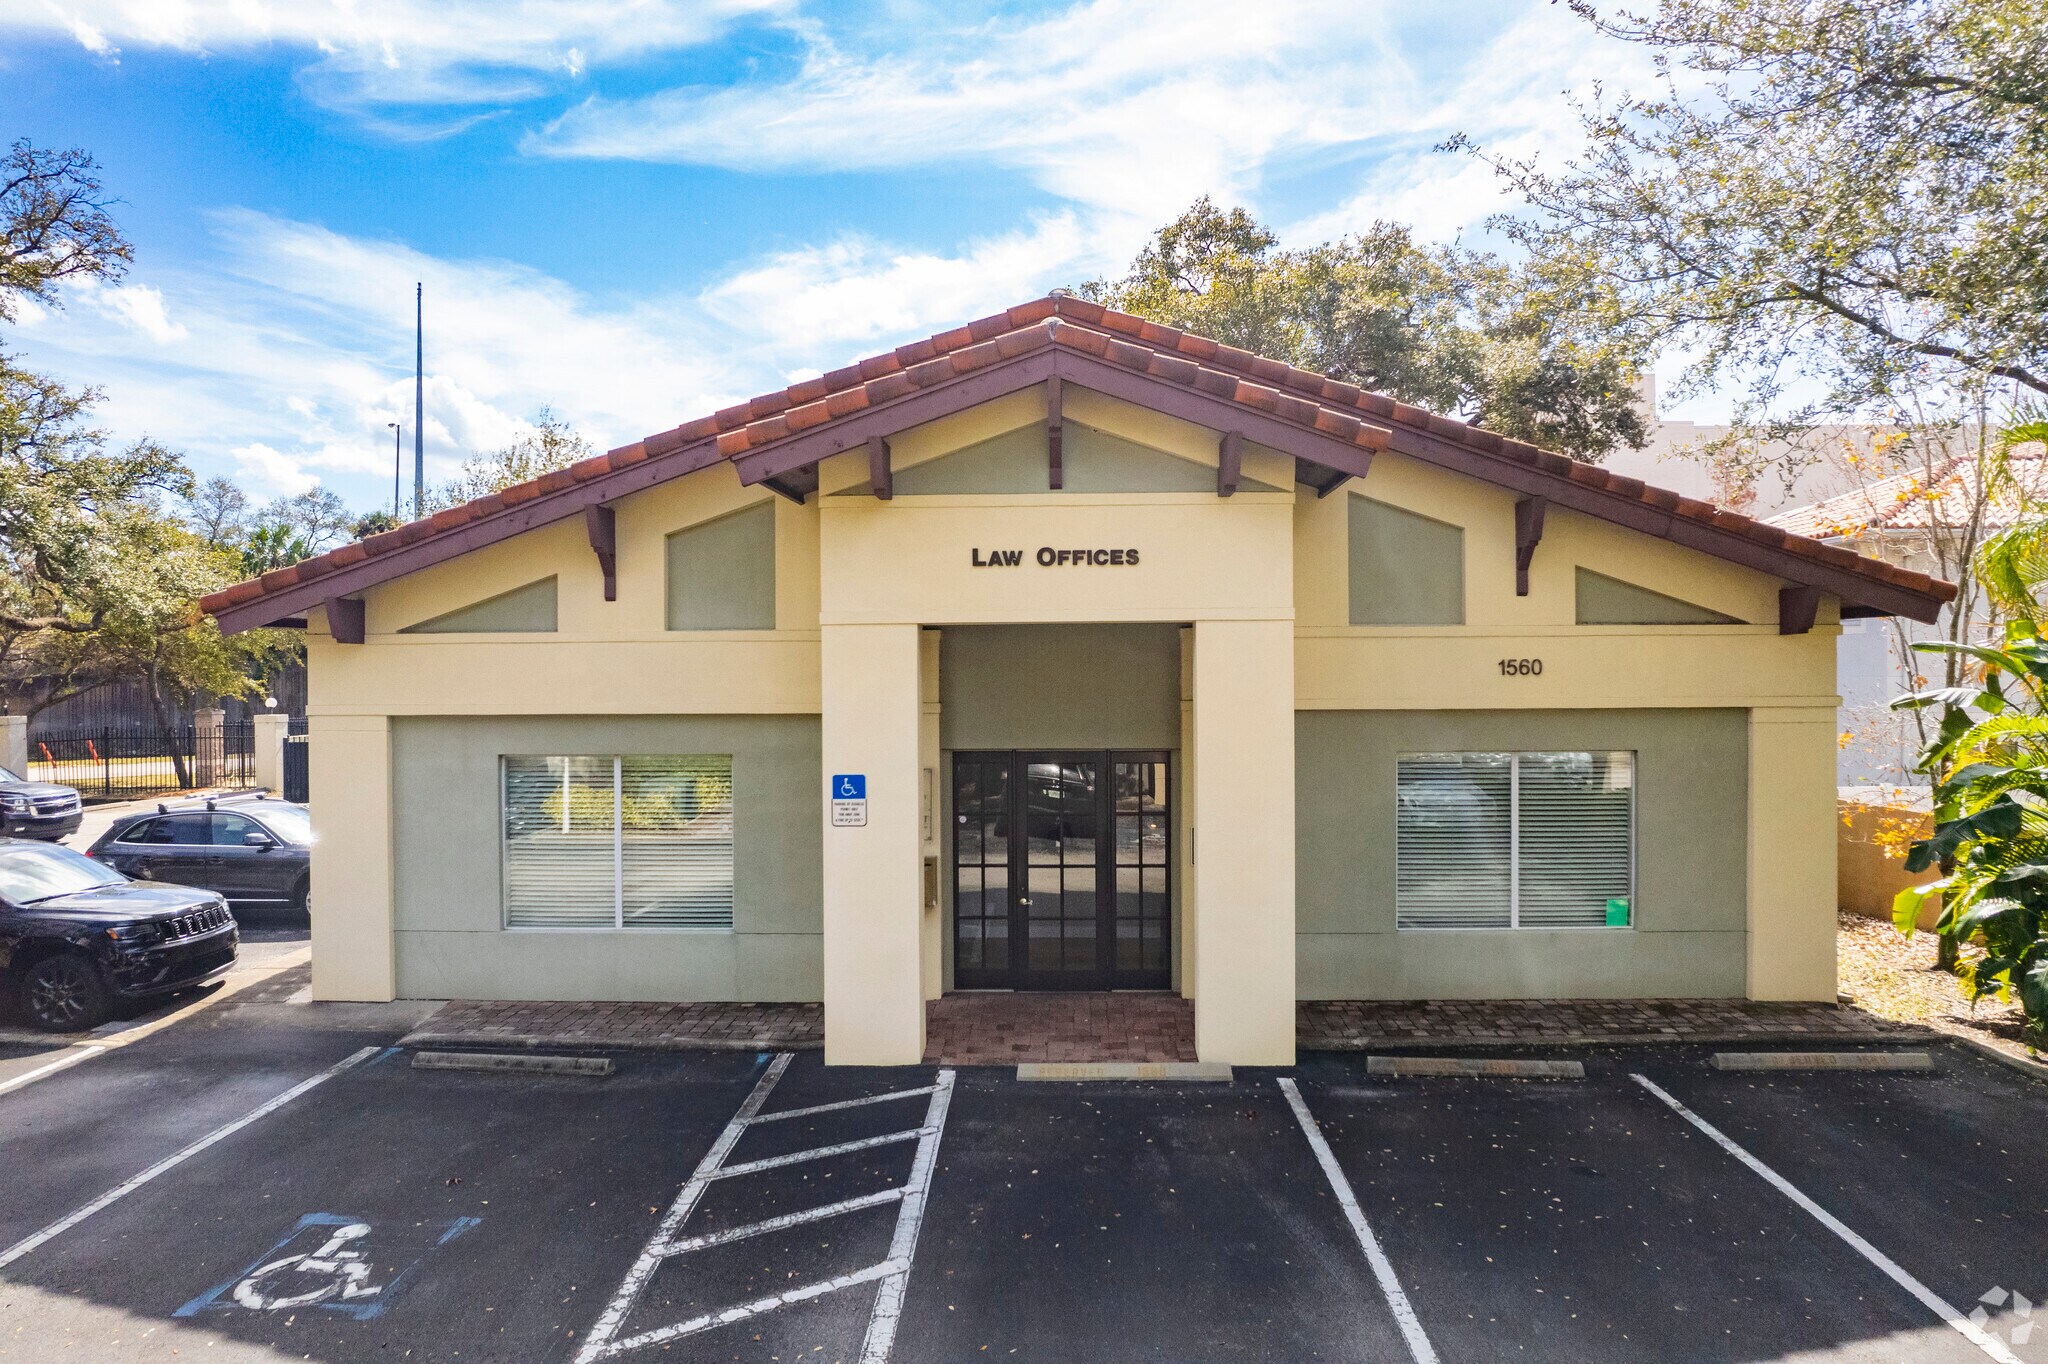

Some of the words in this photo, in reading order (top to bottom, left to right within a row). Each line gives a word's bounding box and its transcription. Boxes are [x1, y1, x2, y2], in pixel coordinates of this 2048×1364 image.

[972, 548, 1023, 567] LAW
[1036, 547, 1140, 567] OFFICES
[1498, 658, 1543, 676] 1560
